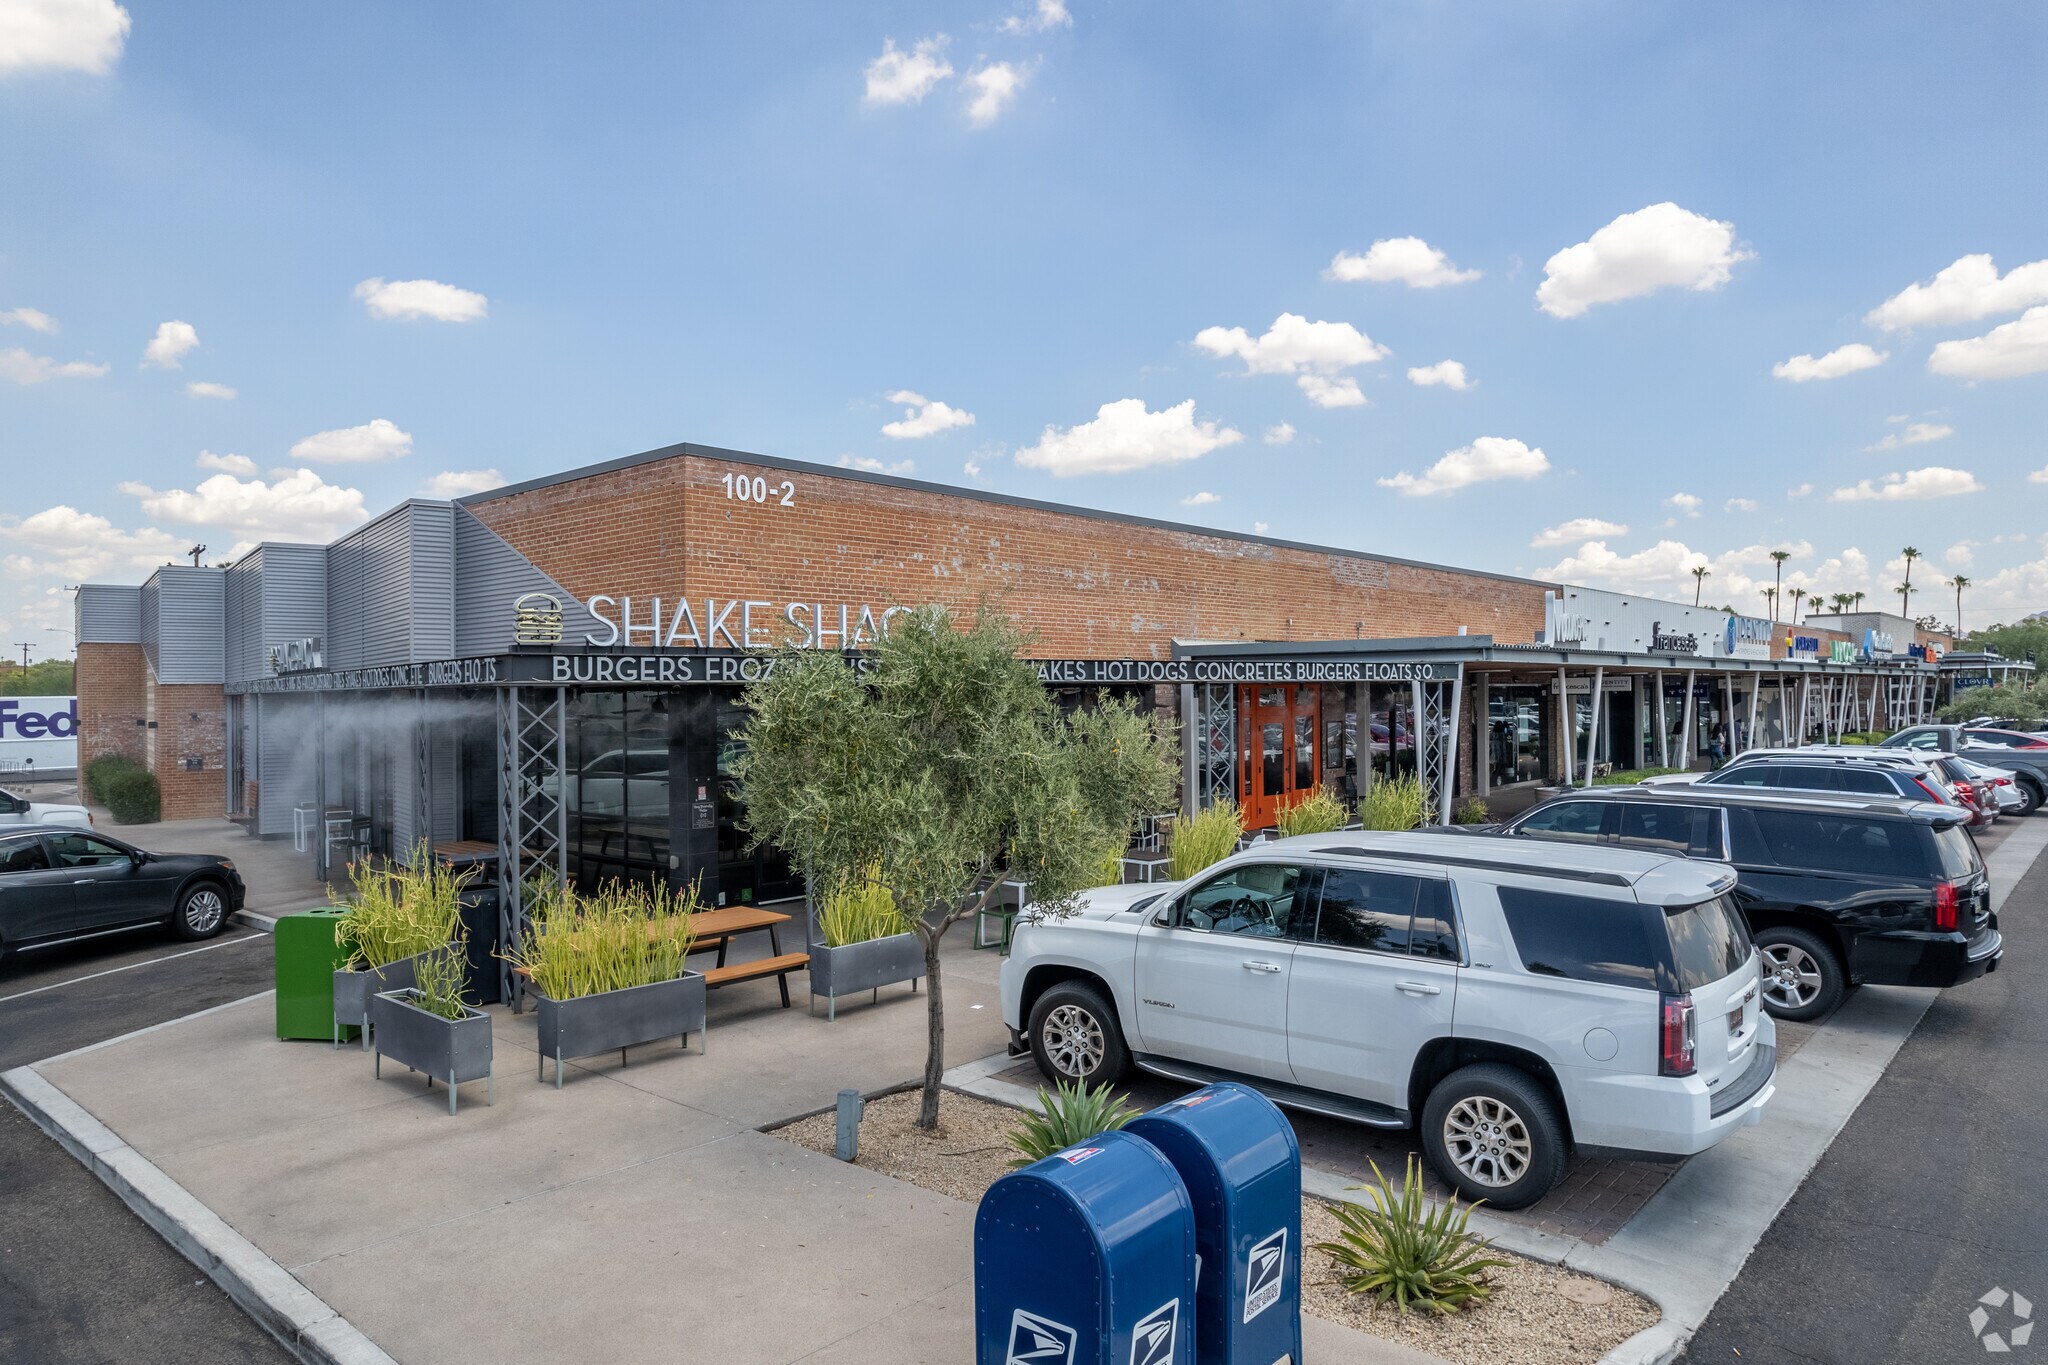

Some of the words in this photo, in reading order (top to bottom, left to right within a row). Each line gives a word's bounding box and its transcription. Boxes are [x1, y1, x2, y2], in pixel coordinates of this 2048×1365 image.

[721, 472, 795, 507] 100-2
[584, 595, 771, 648] SHAKE
[428, 661, 462, 684] BURGERS
[464, 657, 497, 683] FLOTS
[552, 656, 692, 681] BURGERS
[705, 657, 788, 681] FROZ
[1030, 660, 1086, 681] AKES
[1094, 661, 1134, 681] HOT
[1138, 661, 1188, 681] DOGS
[1194, 662, 1292, 680] CONCRETES
[1296, 663, 1360, 680] BURGERS
[1365, 663, 1412, 680] FLOATS
[1414, 664, 1433, 680] SO
[1553, 682, 1589, 690] frcesca's
[1142, 998, 1176, 1009] YUKON
